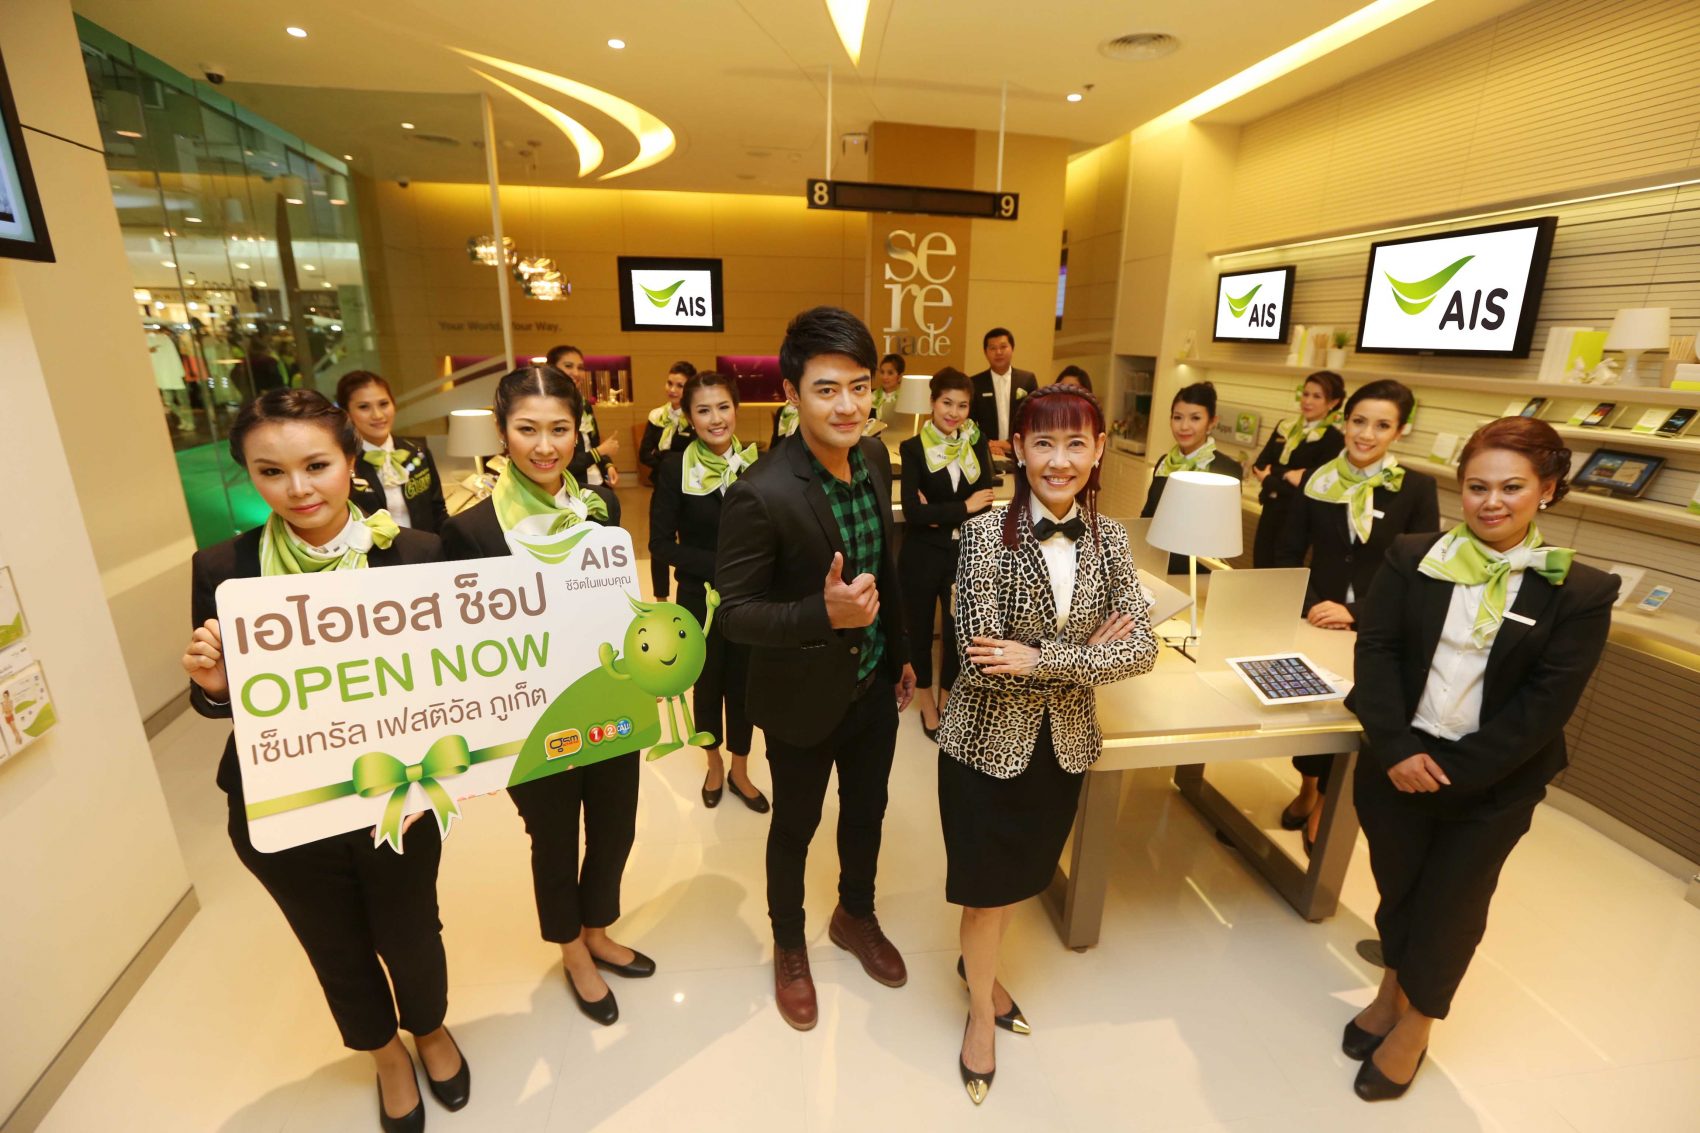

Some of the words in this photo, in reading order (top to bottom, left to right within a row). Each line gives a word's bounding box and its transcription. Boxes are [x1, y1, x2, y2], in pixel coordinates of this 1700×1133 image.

[813, 182, 829, 206] 8
[1000, 195, 1015, 217] 9
[675, 296, 706, 317] AIS
[1248, 303, 1277, 328] AIS
[1438, 287, 1509, 331] AIS
[580, 545, 628, 571] AIS
[565, 576, 632, 591] ชีวิตในแบบคุณ
[235, 591, 443, 655] เอไอเอส
[455, 571, 547, 625] ช็อป
[241, 653, 414, 718] OPEN
[431, 631, 550, 687] NOW
[251, 721, 367, 766] เซ็นทรัล
[376, 698, 482, 739] เฟสติวัล
[489, 681, 547, 722] ภูเก็ต
